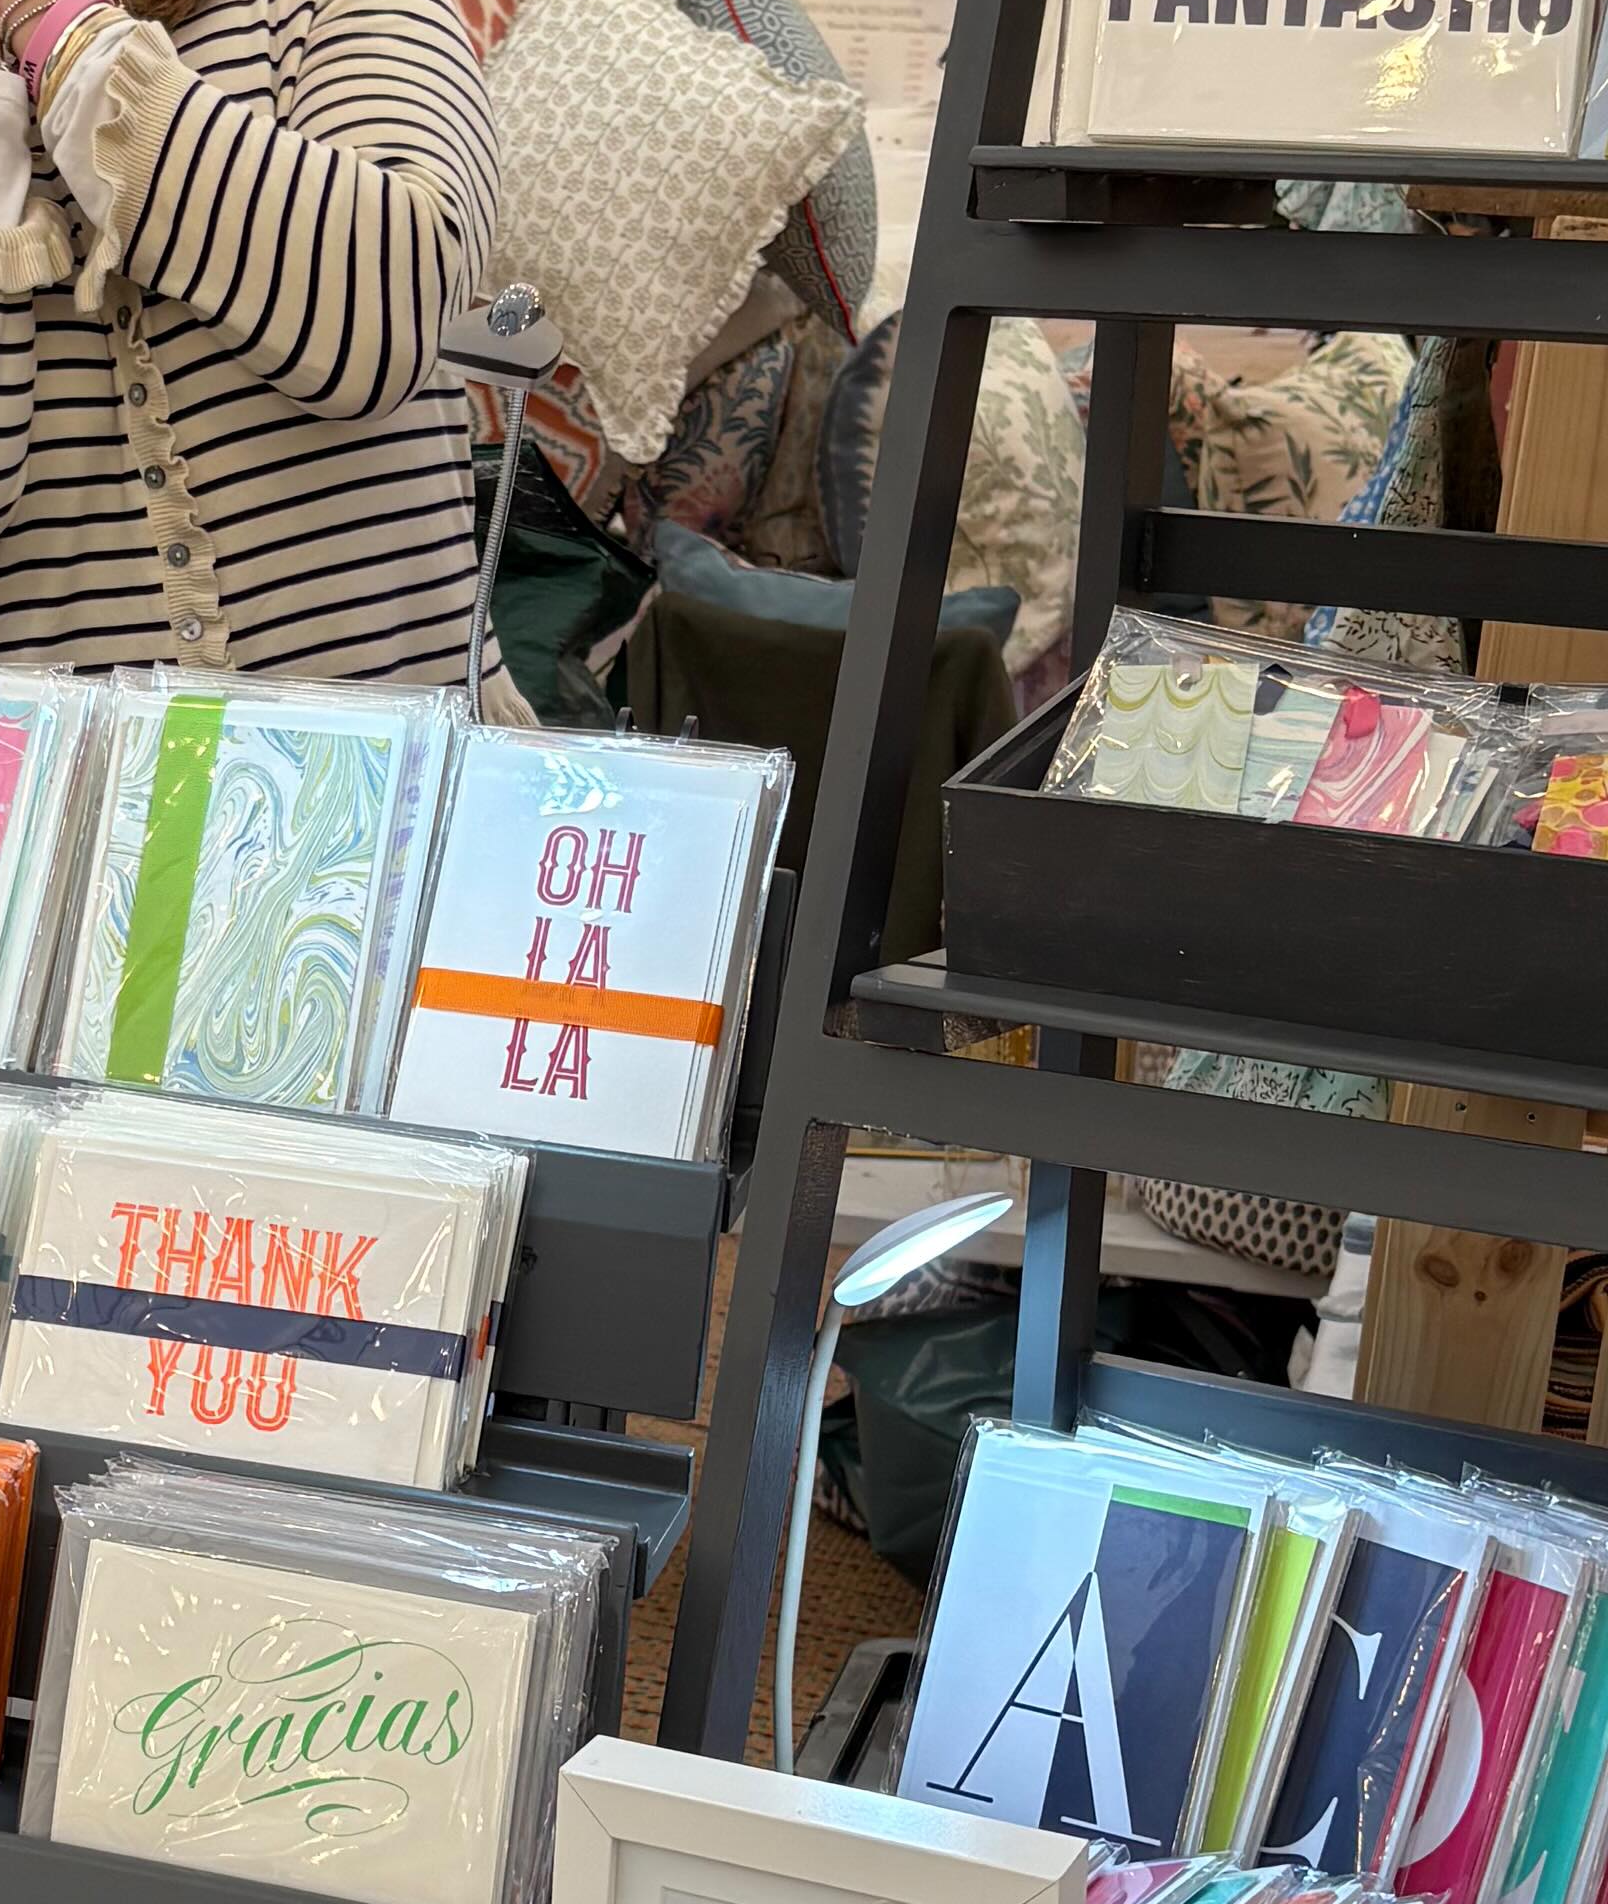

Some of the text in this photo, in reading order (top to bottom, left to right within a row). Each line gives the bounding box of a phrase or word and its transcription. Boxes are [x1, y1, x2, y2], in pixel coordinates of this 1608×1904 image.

[536, 824, 647, 914] OH
[500, 1016, 592, 1100] LA
[110, 1202, 379, 1321] THANK
[145, 1337, 297, 1433] YOU
[113, 1626, 473, 1815] Gracias
[926, 1571, 1161, 1846] A
